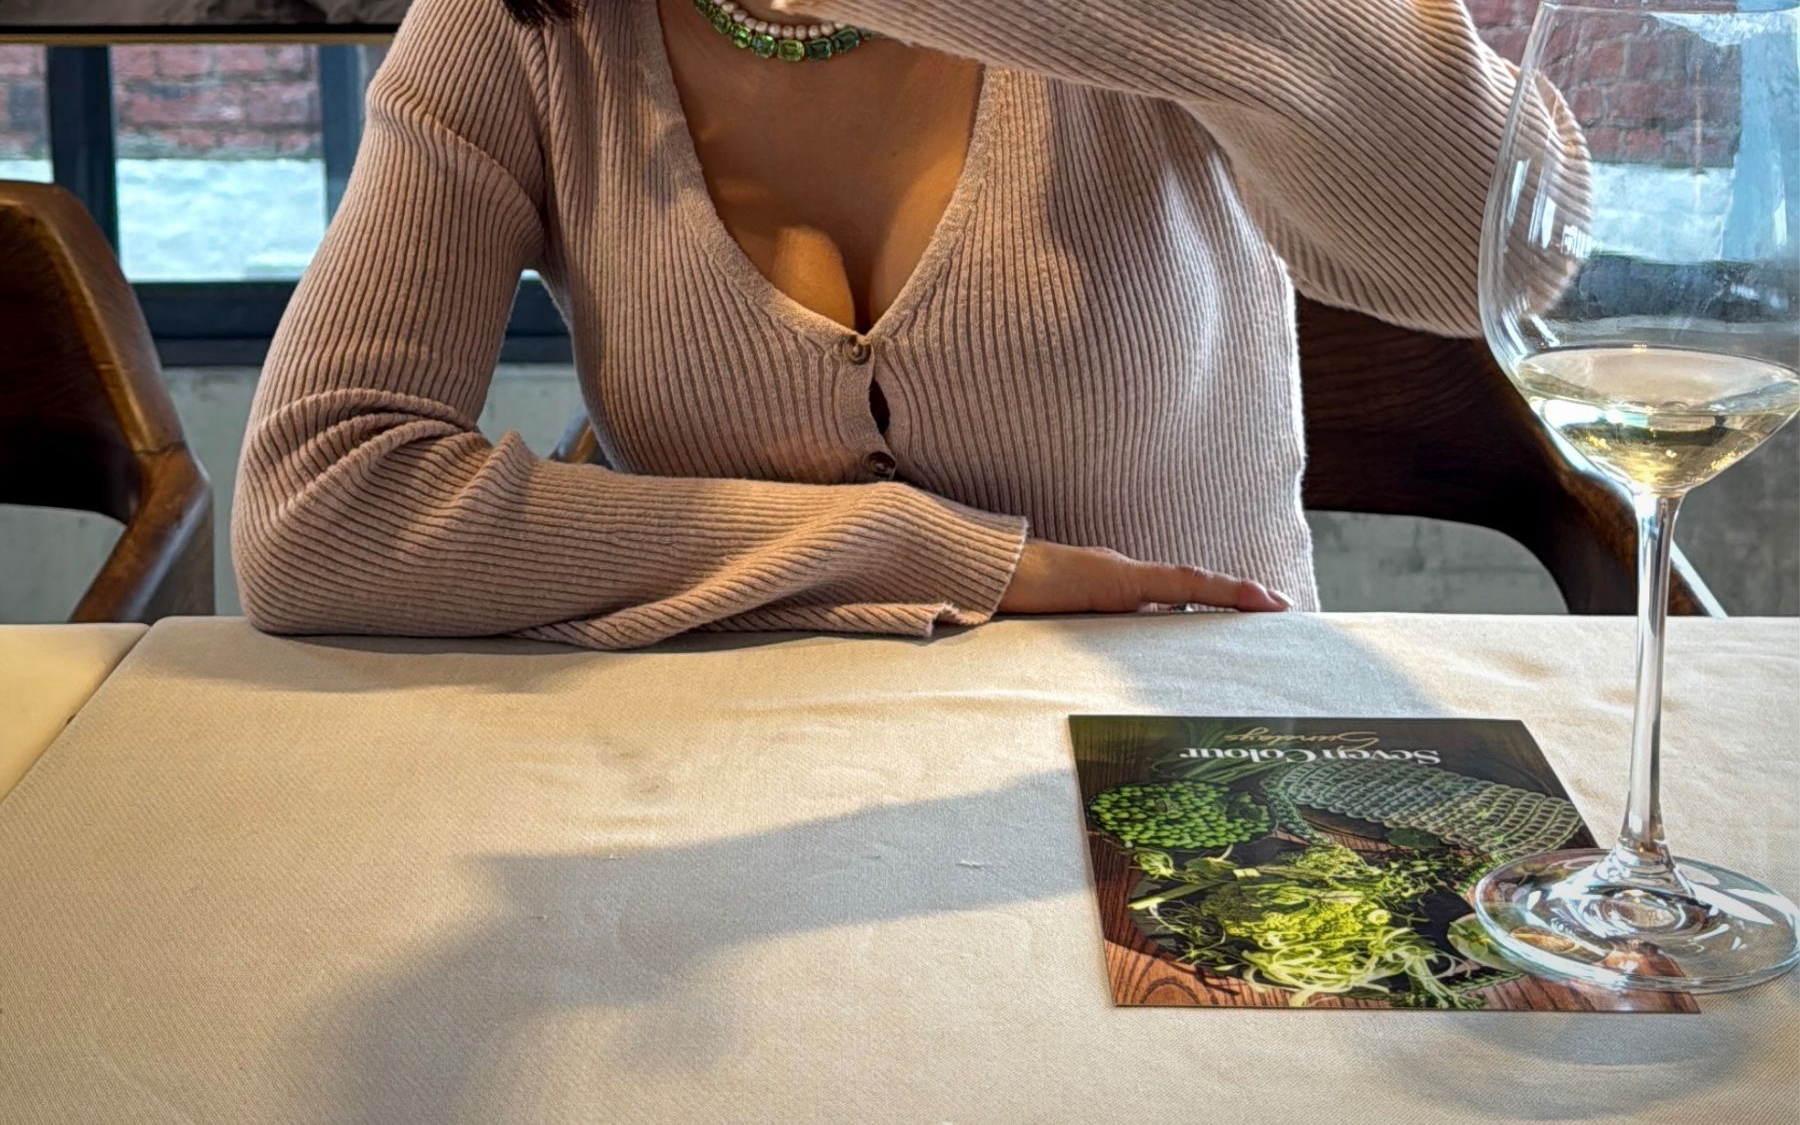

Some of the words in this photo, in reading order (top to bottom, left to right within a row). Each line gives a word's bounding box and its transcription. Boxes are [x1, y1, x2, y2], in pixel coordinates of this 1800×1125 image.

[1223, 727, 1379, 751] Sundays
[1179, 747, 1317, 763] Colour
[1321, 748, 1441, 764] Seven
